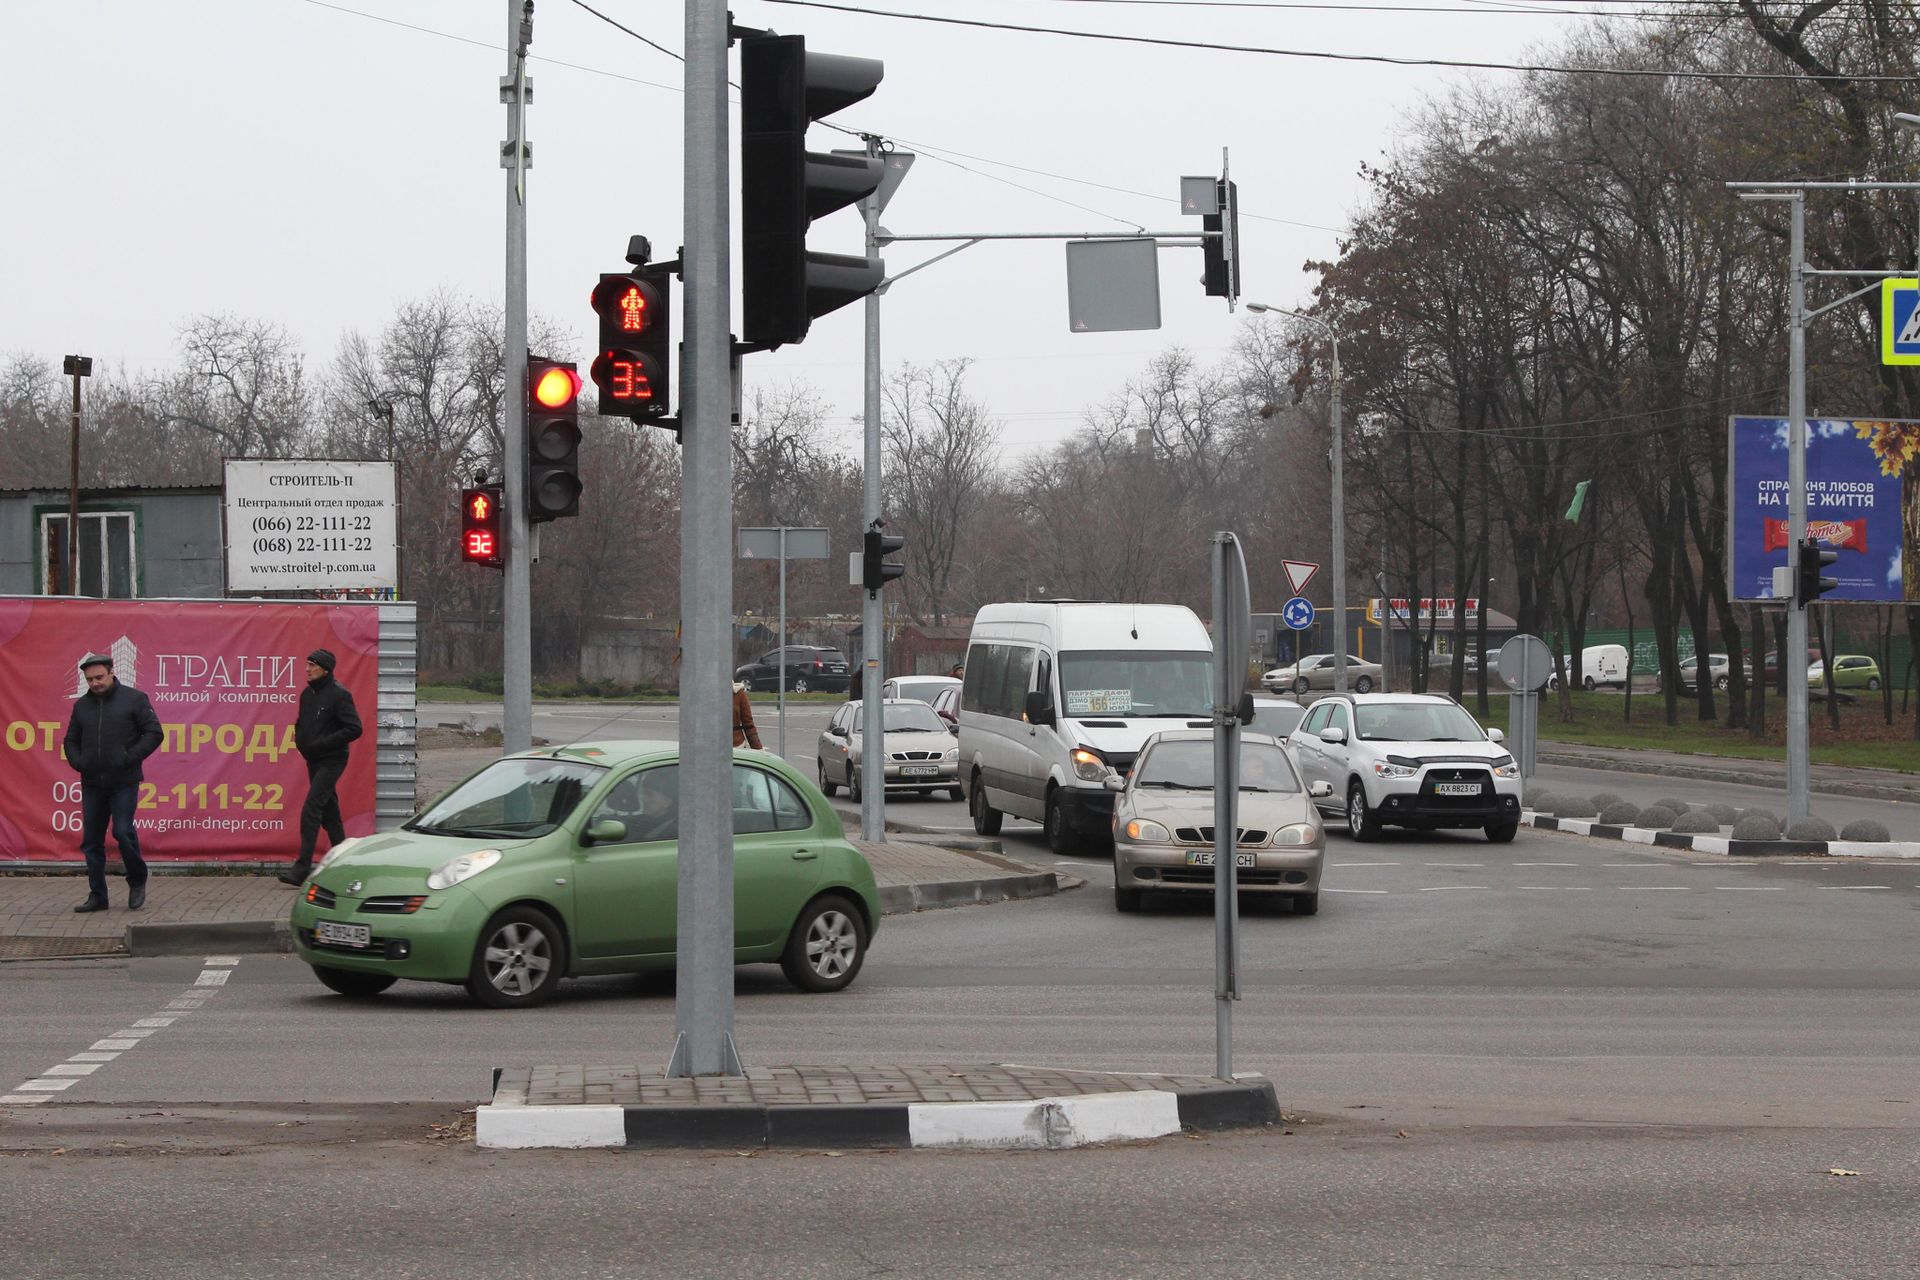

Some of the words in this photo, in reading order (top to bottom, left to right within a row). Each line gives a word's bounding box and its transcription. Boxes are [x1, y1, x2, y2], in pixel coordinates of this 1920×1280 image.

[269, 475, 353, 487] СТРОИТЕЛЬ-П
[1758, 480, 1826, 491] СПРАНЯ
[1829, 482, 1874, 493] ЛЮБОВ
[237, 498, 312, 509] Центральный
[314, 500, 343, 508] отдел
[346, 499, 384, 508] продаж
[1758, 492, 1780, 505] НА
[1820, 493, 1874, 507] ЖИТТЯ
[252, 516, 292, 534] (066)
[296, 516, 371, 531] 22-111-22
[253, 537, 292, 555] (068)
[297, 537, 372, 551] 22-111-22
[470, 534, 492, 554] 32
[250, 562, 376, 575] www.stroitel-p.com.ua
[155, 654, 297, 688] ГРАНИ
[155, 689, 210, 703] жилой
[218, 692, 297, 704] комплекс
[1090, 697, 1108, 711] 156
[161, 723, 300, 762] ПРОДА
[53, 781, 83, 803] 06
[137, 783, 284, 810] 2-111-22
[52, 810, 83, 832] 06
[1194, 854, 1209, 865] AE
[1237, 855, 1252, 866] CH
